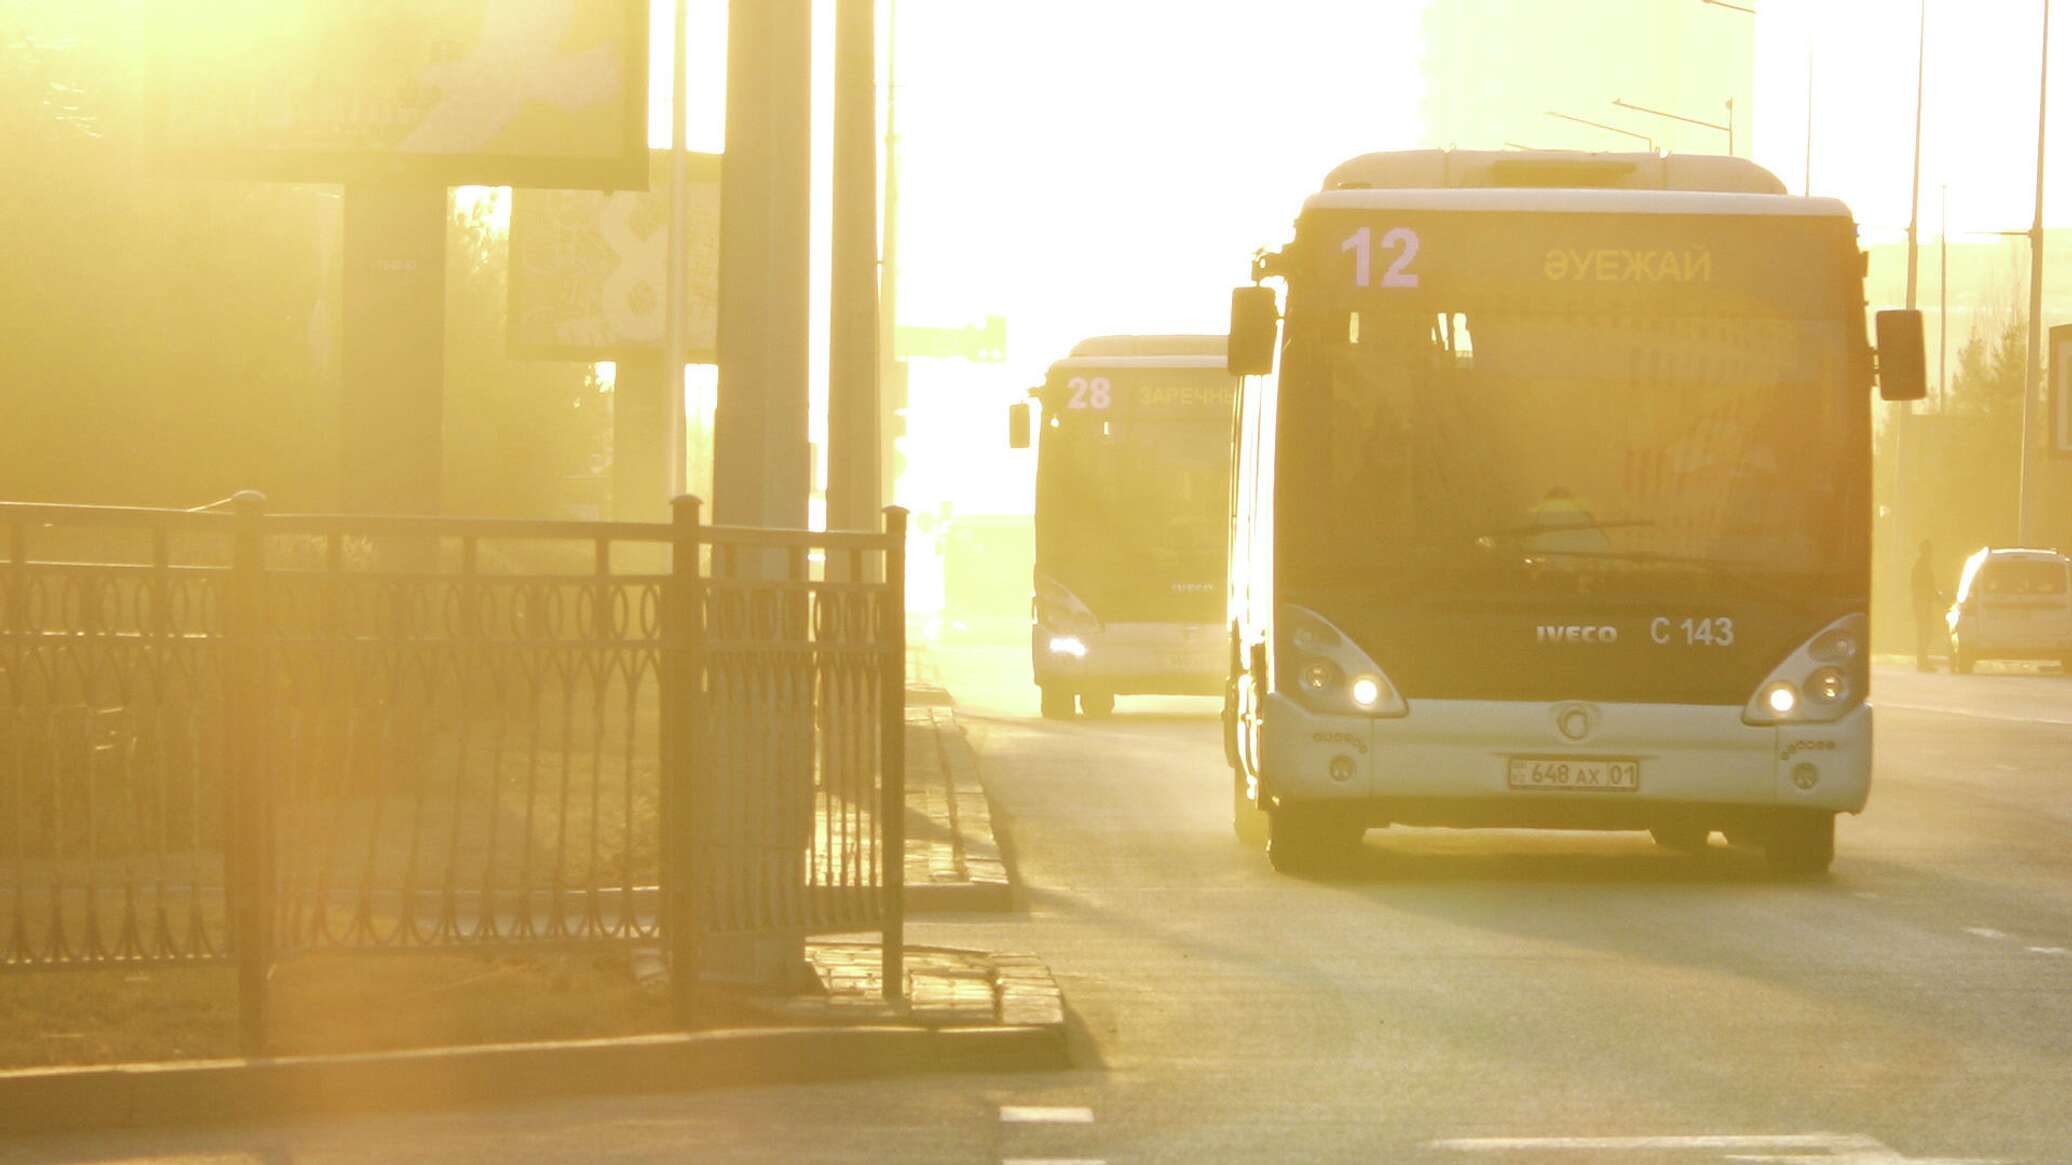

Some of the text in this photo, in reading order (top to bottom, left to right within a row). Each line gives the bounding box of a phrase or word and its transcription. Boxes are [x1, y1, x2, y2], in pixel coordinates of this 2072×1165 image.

[1341, 227, 1419, 288] 12
[1544, 243, 1710, 283] ӘУЕЖАЙ
[1066, 376, 1112, 410] 28
[1536, 625, 1618, 643] IVECO
[1650, 617, 1734, 646] C 143
[1531, 763, 1570, 784] 648
[1576, 768, 1600, 784] AX
[1610, 764, 1635, 785] 01
